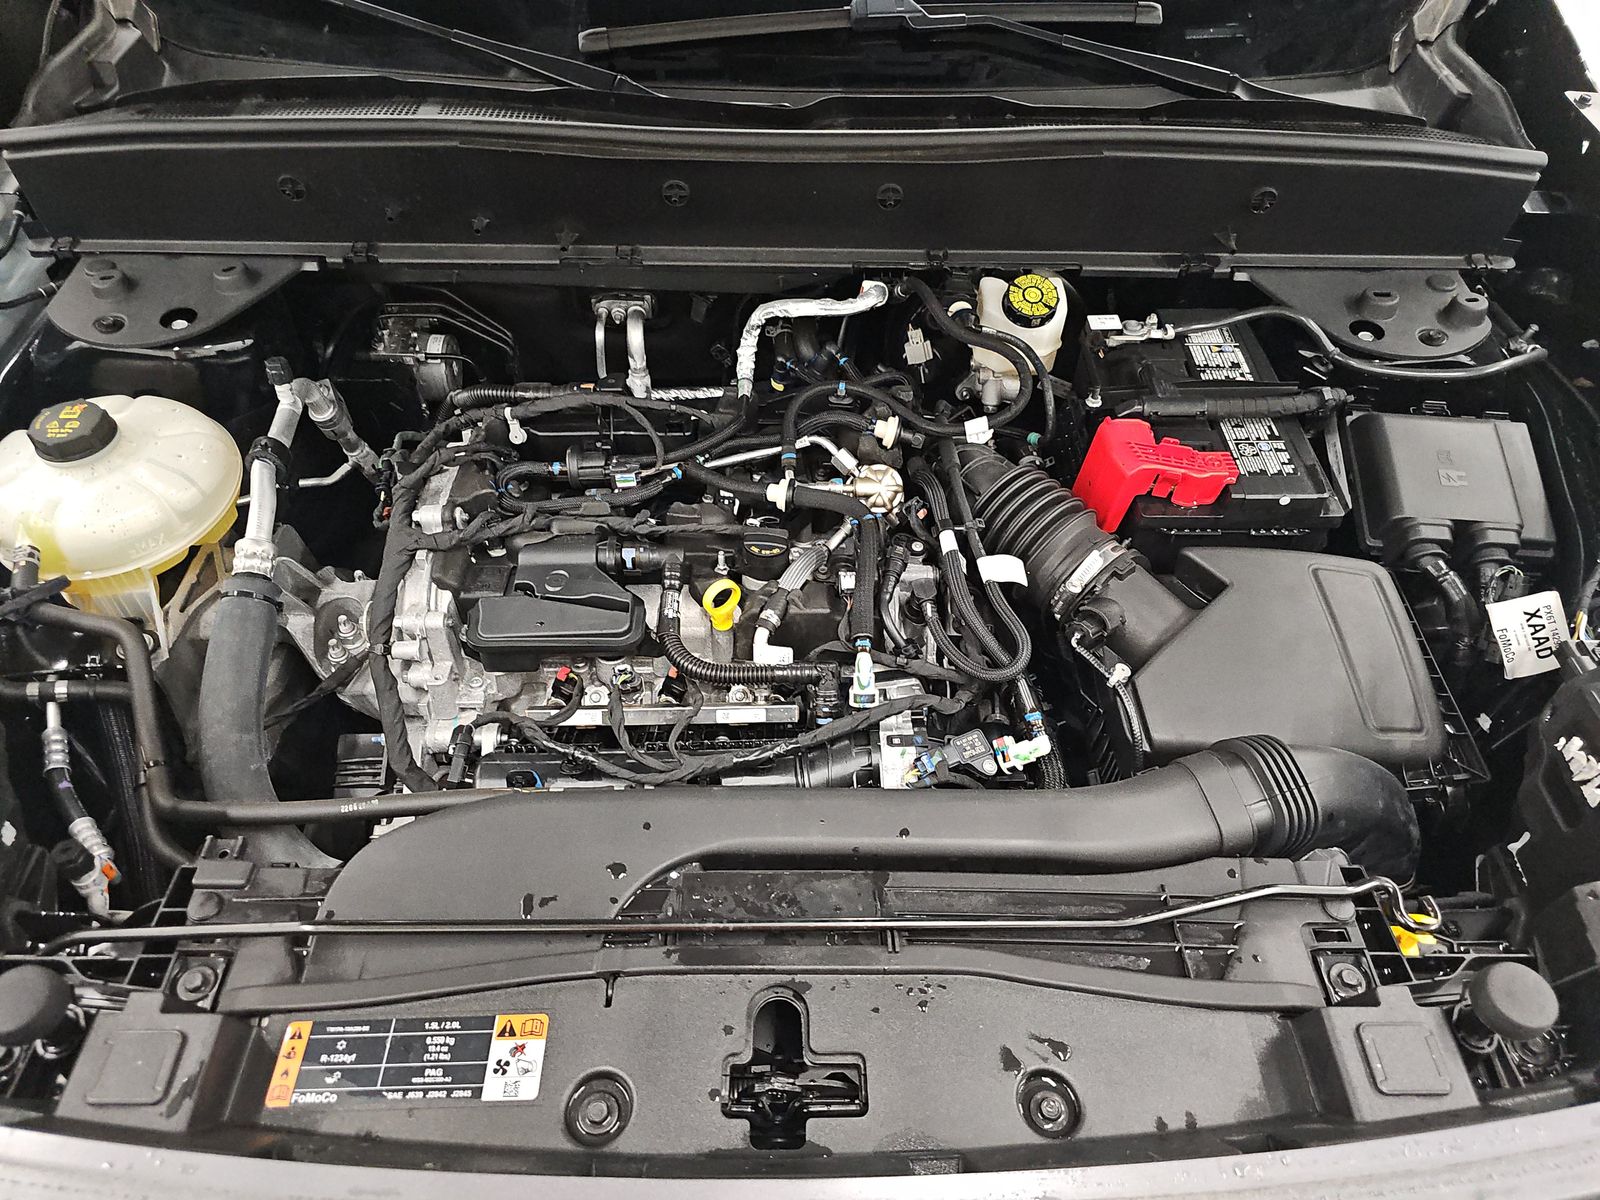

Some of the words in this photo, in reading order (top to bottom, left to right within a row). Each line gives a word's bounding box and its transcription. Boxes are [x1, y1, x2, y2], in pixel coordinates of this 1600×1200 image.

[1543, 604, 1557, 625] PX6T
[1550, 627, 1561, 649] 1429
[1523, 607, 1554, 660] XAAD
[1496, 627, 1516, 664] FoMoCo
[445, 1021, 461, 1029] 2.0L
[445, 1036, 455, 1046] kg
[320, 1053, 357, 1064] R-1234yf
[424, 1068, 443, 1077] PAG
[290, 1091, 338, 1104] FoMoCo
